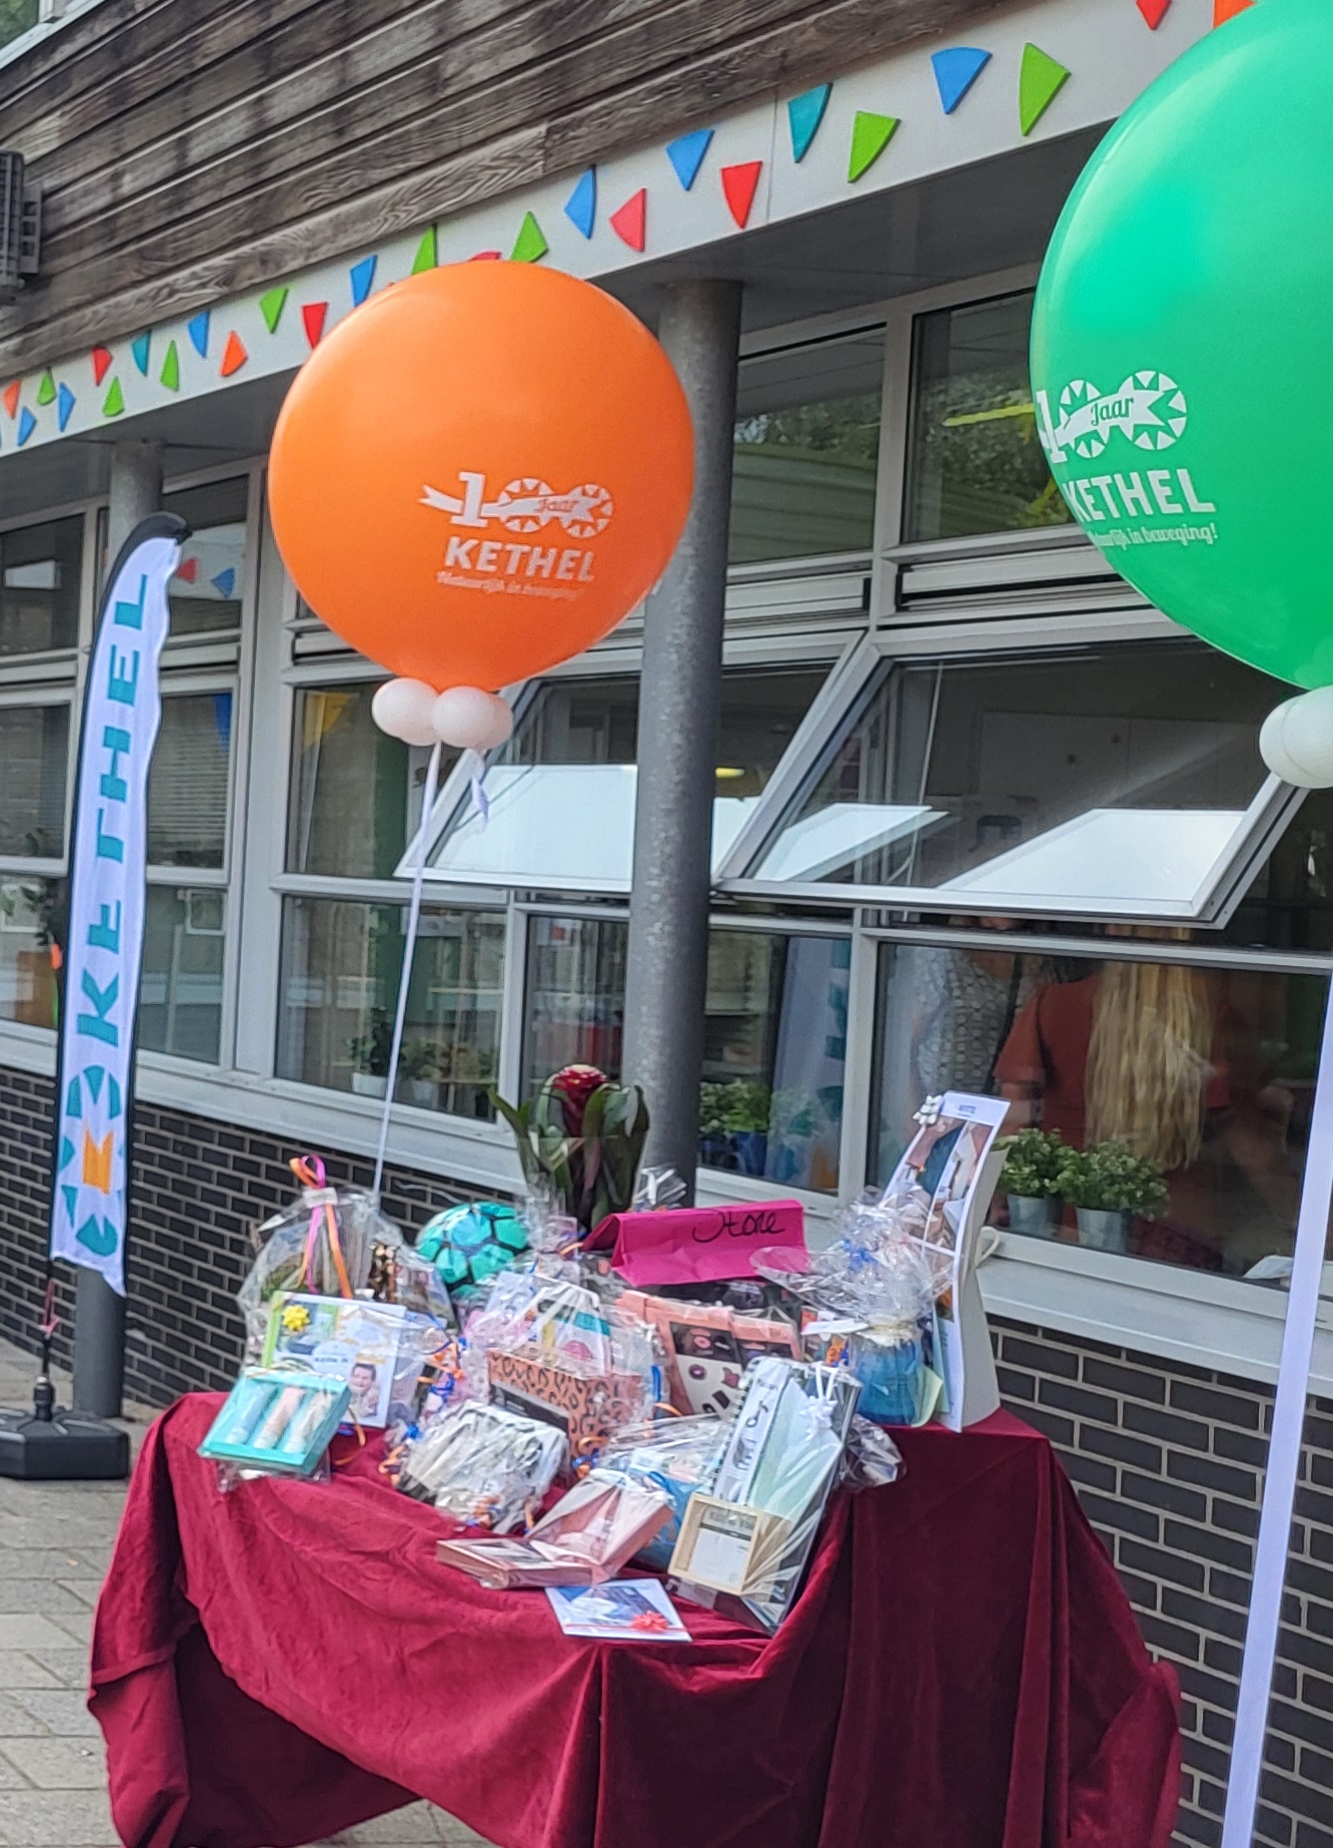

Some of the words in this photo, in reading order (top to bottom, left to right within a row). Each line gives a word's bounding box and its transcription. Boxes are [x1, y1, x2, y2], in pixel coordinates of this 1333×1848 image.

[1090, 397, 1135, 427] Jaar
[449, 470, 614, 538] 100
[1062, 468, 1216, 523] KETHEL
[443, 535, 595, 582] KETHEL
[76, 573, 149, 1049] KETHEL
